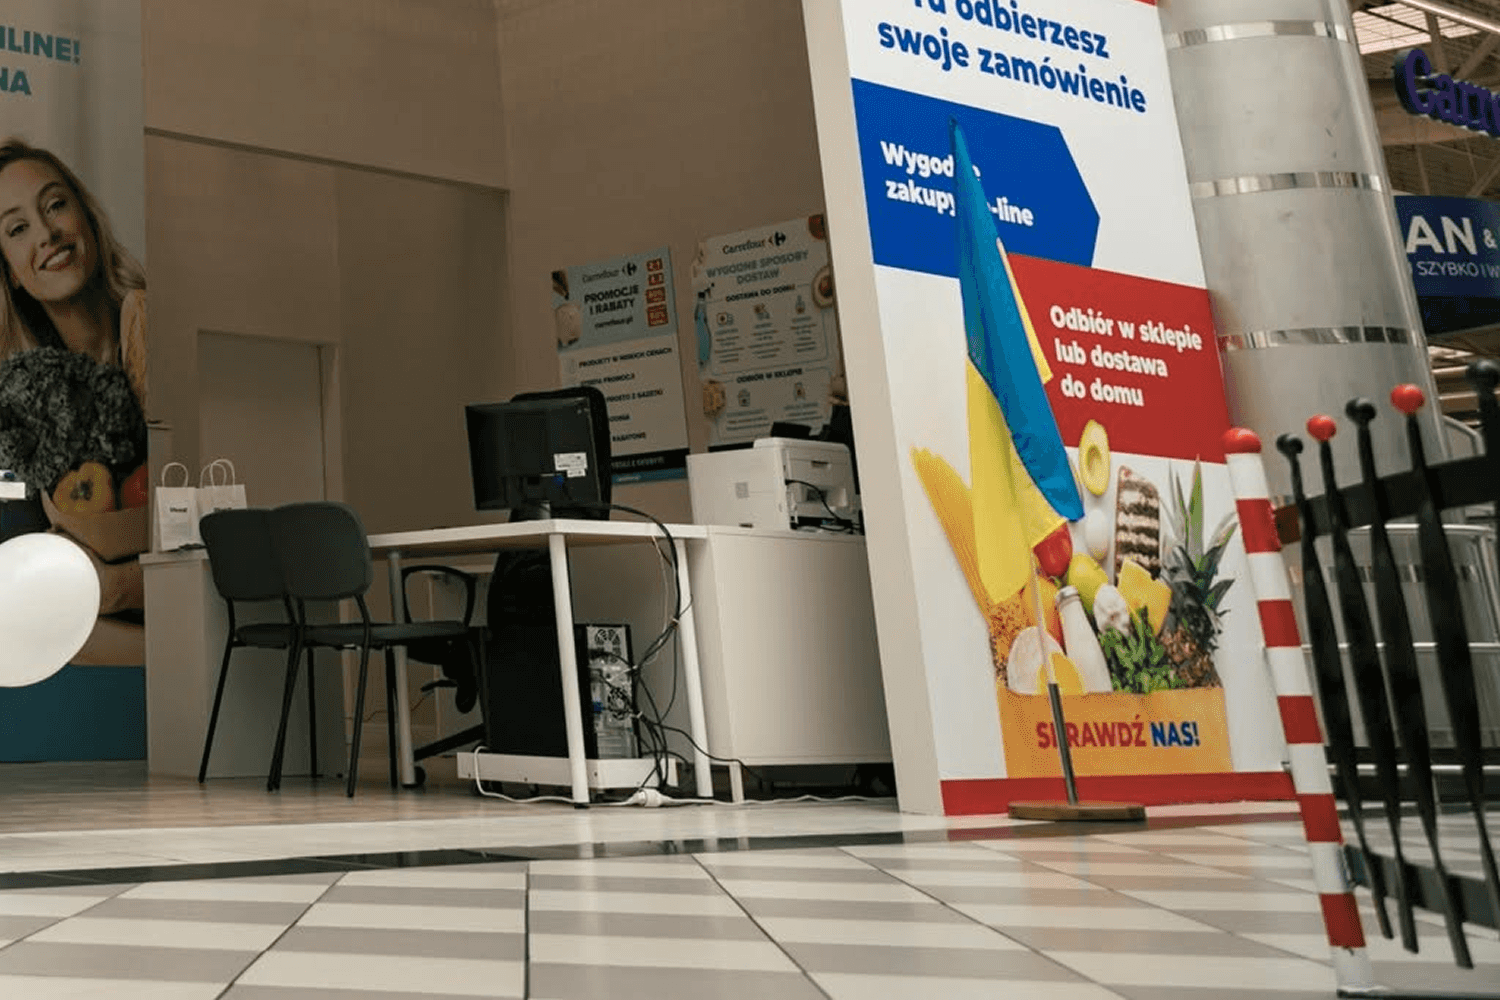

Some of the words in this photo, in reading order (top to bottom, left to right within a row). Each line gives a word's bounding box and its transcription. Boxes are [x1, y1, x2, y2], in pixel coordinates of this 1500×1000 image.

[877, 21, 969, 72] swoje
[978, 46, 1146, 113] zamówienie
[880, 140, 981, 182] Wygod
[1416, 260, 1480, 277] SZYBKO
[584, 284, 639, 304] PROMOCJE
[595, 298, 636, 314] RABATY
[1050, 304, 1114, 336] Odbiór
[1117, 320, 1135, 340] w
[1139, 319, 1202, 353] sklepie
[1054, 337, 1087, 366] lub
[1090, 344, 1168, 378] dostawa
[1060, 373, 1086, 399] do
[1090, 377, 1145, 407] domu
[1150, 721, 1201, 747] NAS!
